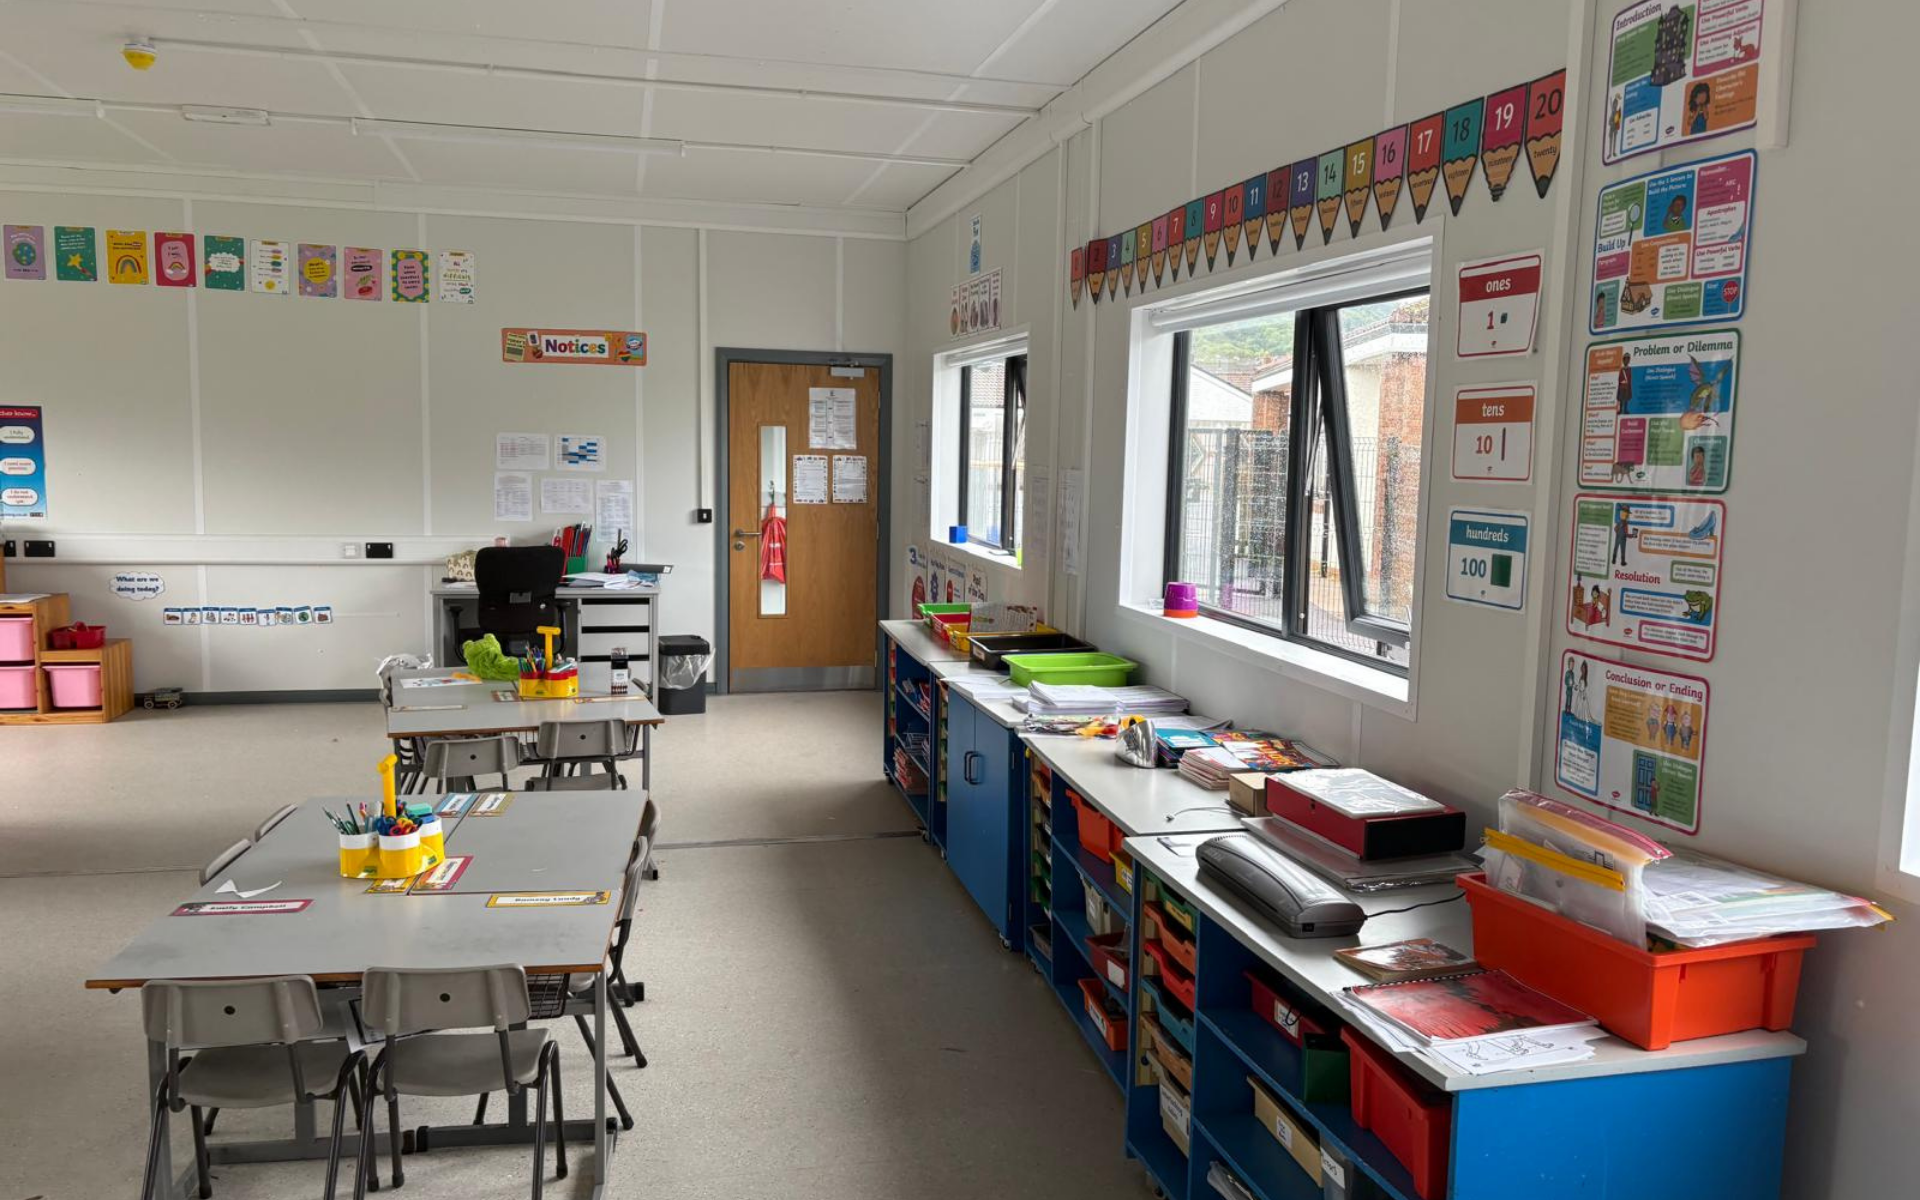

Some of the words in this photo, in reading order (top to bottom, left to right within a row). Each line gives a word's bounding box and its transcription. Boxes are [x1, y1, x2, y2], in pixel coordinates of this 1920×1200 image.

[1616, 3, 1661, 31] Introduction
[1535, 88, 1562, 120] 20
[1495, 103, 1514, 131] 19
[1453, 117, 1471, 144] 18
[1417, 129, 1433, 155] 17
[1382, 141, 1396, 165] 16
[1533, 145, 1557, 159] twenty
[1352, 152, 1365, 176] 15
[1297, 171, 1309, 192] 13
[1324, 162, 1337, 185] 14
[1250, 186, 1259, 206] 11
[1271, 180, 1284, 199] 12
[1210, 202, 1216, 220] 9
[1228, 195, 1238, 214] 10
[1173, 216, 1180, 233] 7
[1191, 209, 1197, 226] 8
[1141, 232, 1147, 248] 5
[1157, 225, 1162, 241] 6
[1110, 243, 1117, 259] 3
[1597, 240, 1615, 253] Build
[1615, 238, 1626, 250] Up
[1485, 277, 1512, 293] ones
[1723, 286, 1738, 296] STOP
[1487, 310, 1494, 330] 1
[545, 338, 606, 355] Notices
[1633, 344, 1670, 356] Problem
[1673, 345, 1684, 354] or
[1687, 340, 1733, 353] Dilemma
[1481, 402, 1505, 417] tens
[1475, 434, 1493, 455] 10
[1465, 525, 1509, 543] hundreds
[909, 547, 918, 565] 3
[1460, 557, 1487, 578] 100
[116, 575, 135, 583] What
[1614, 570, 1661, 585] Resolution
[116, 584, 135, 594] doing
[136, 584, 160, 594] today?
[1605, 669, 1652, 689] Conclusion
[1655, 682, 1667, 691] or
[1669, 683, 1703, 702] Ending
